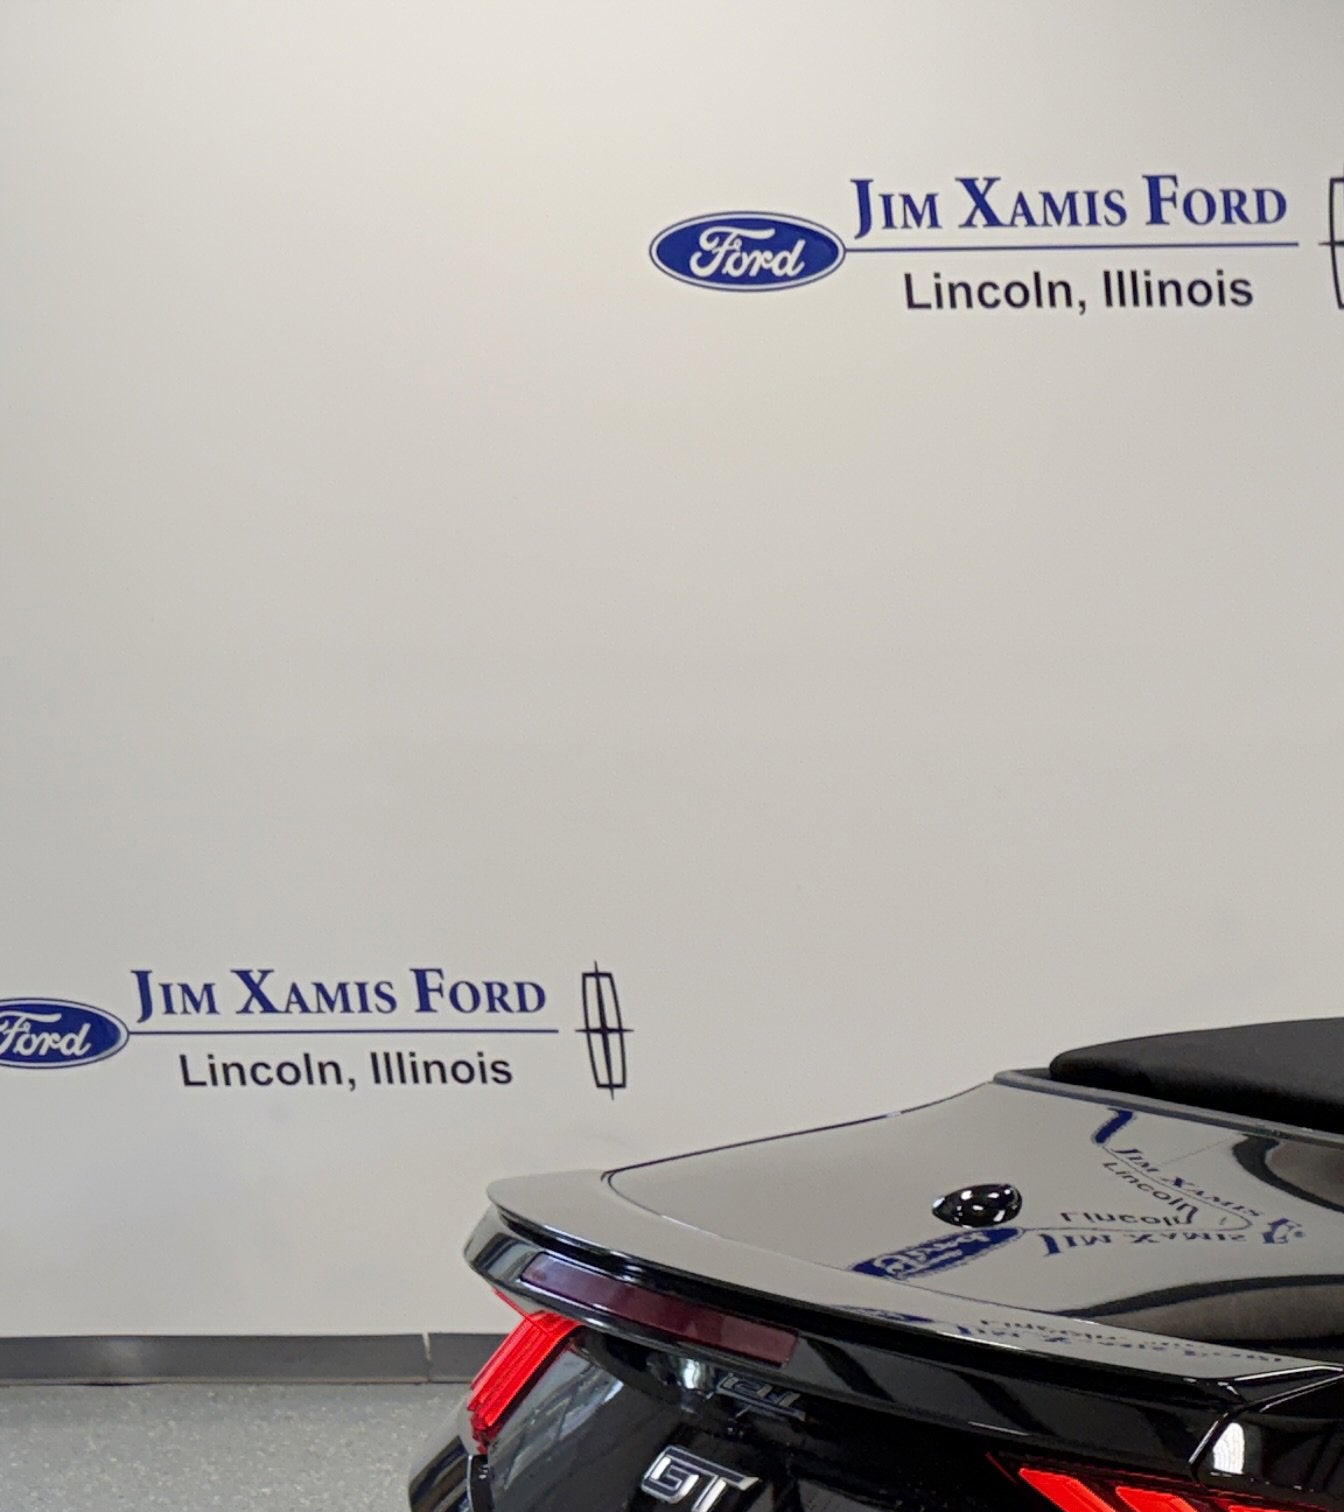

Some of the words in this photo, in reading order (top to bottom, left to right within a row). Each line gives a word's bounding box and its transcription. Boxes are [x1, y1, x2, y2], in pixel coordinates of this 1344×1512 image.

[849, 179, 942, 239] JIM
[955, 176, 1128, 228] XAMIS
[1142, 174, 1288, 226] FORD
[689, 226, 806, 278] Ford
[904, 271, 1087, 315] Lincoln,
[1103, 269, 1254, 308] Illinois
[130, 970, 220, 1023] JIM
[230, 969, 397, 1015] XAMIS
[409, 968, 546, 1014] FORD
[0, 1011, 91, 1056] Ford
[179, 1052, 357, 1092] Lincoln,
[370, 1051, 513, 1085] Illinois
